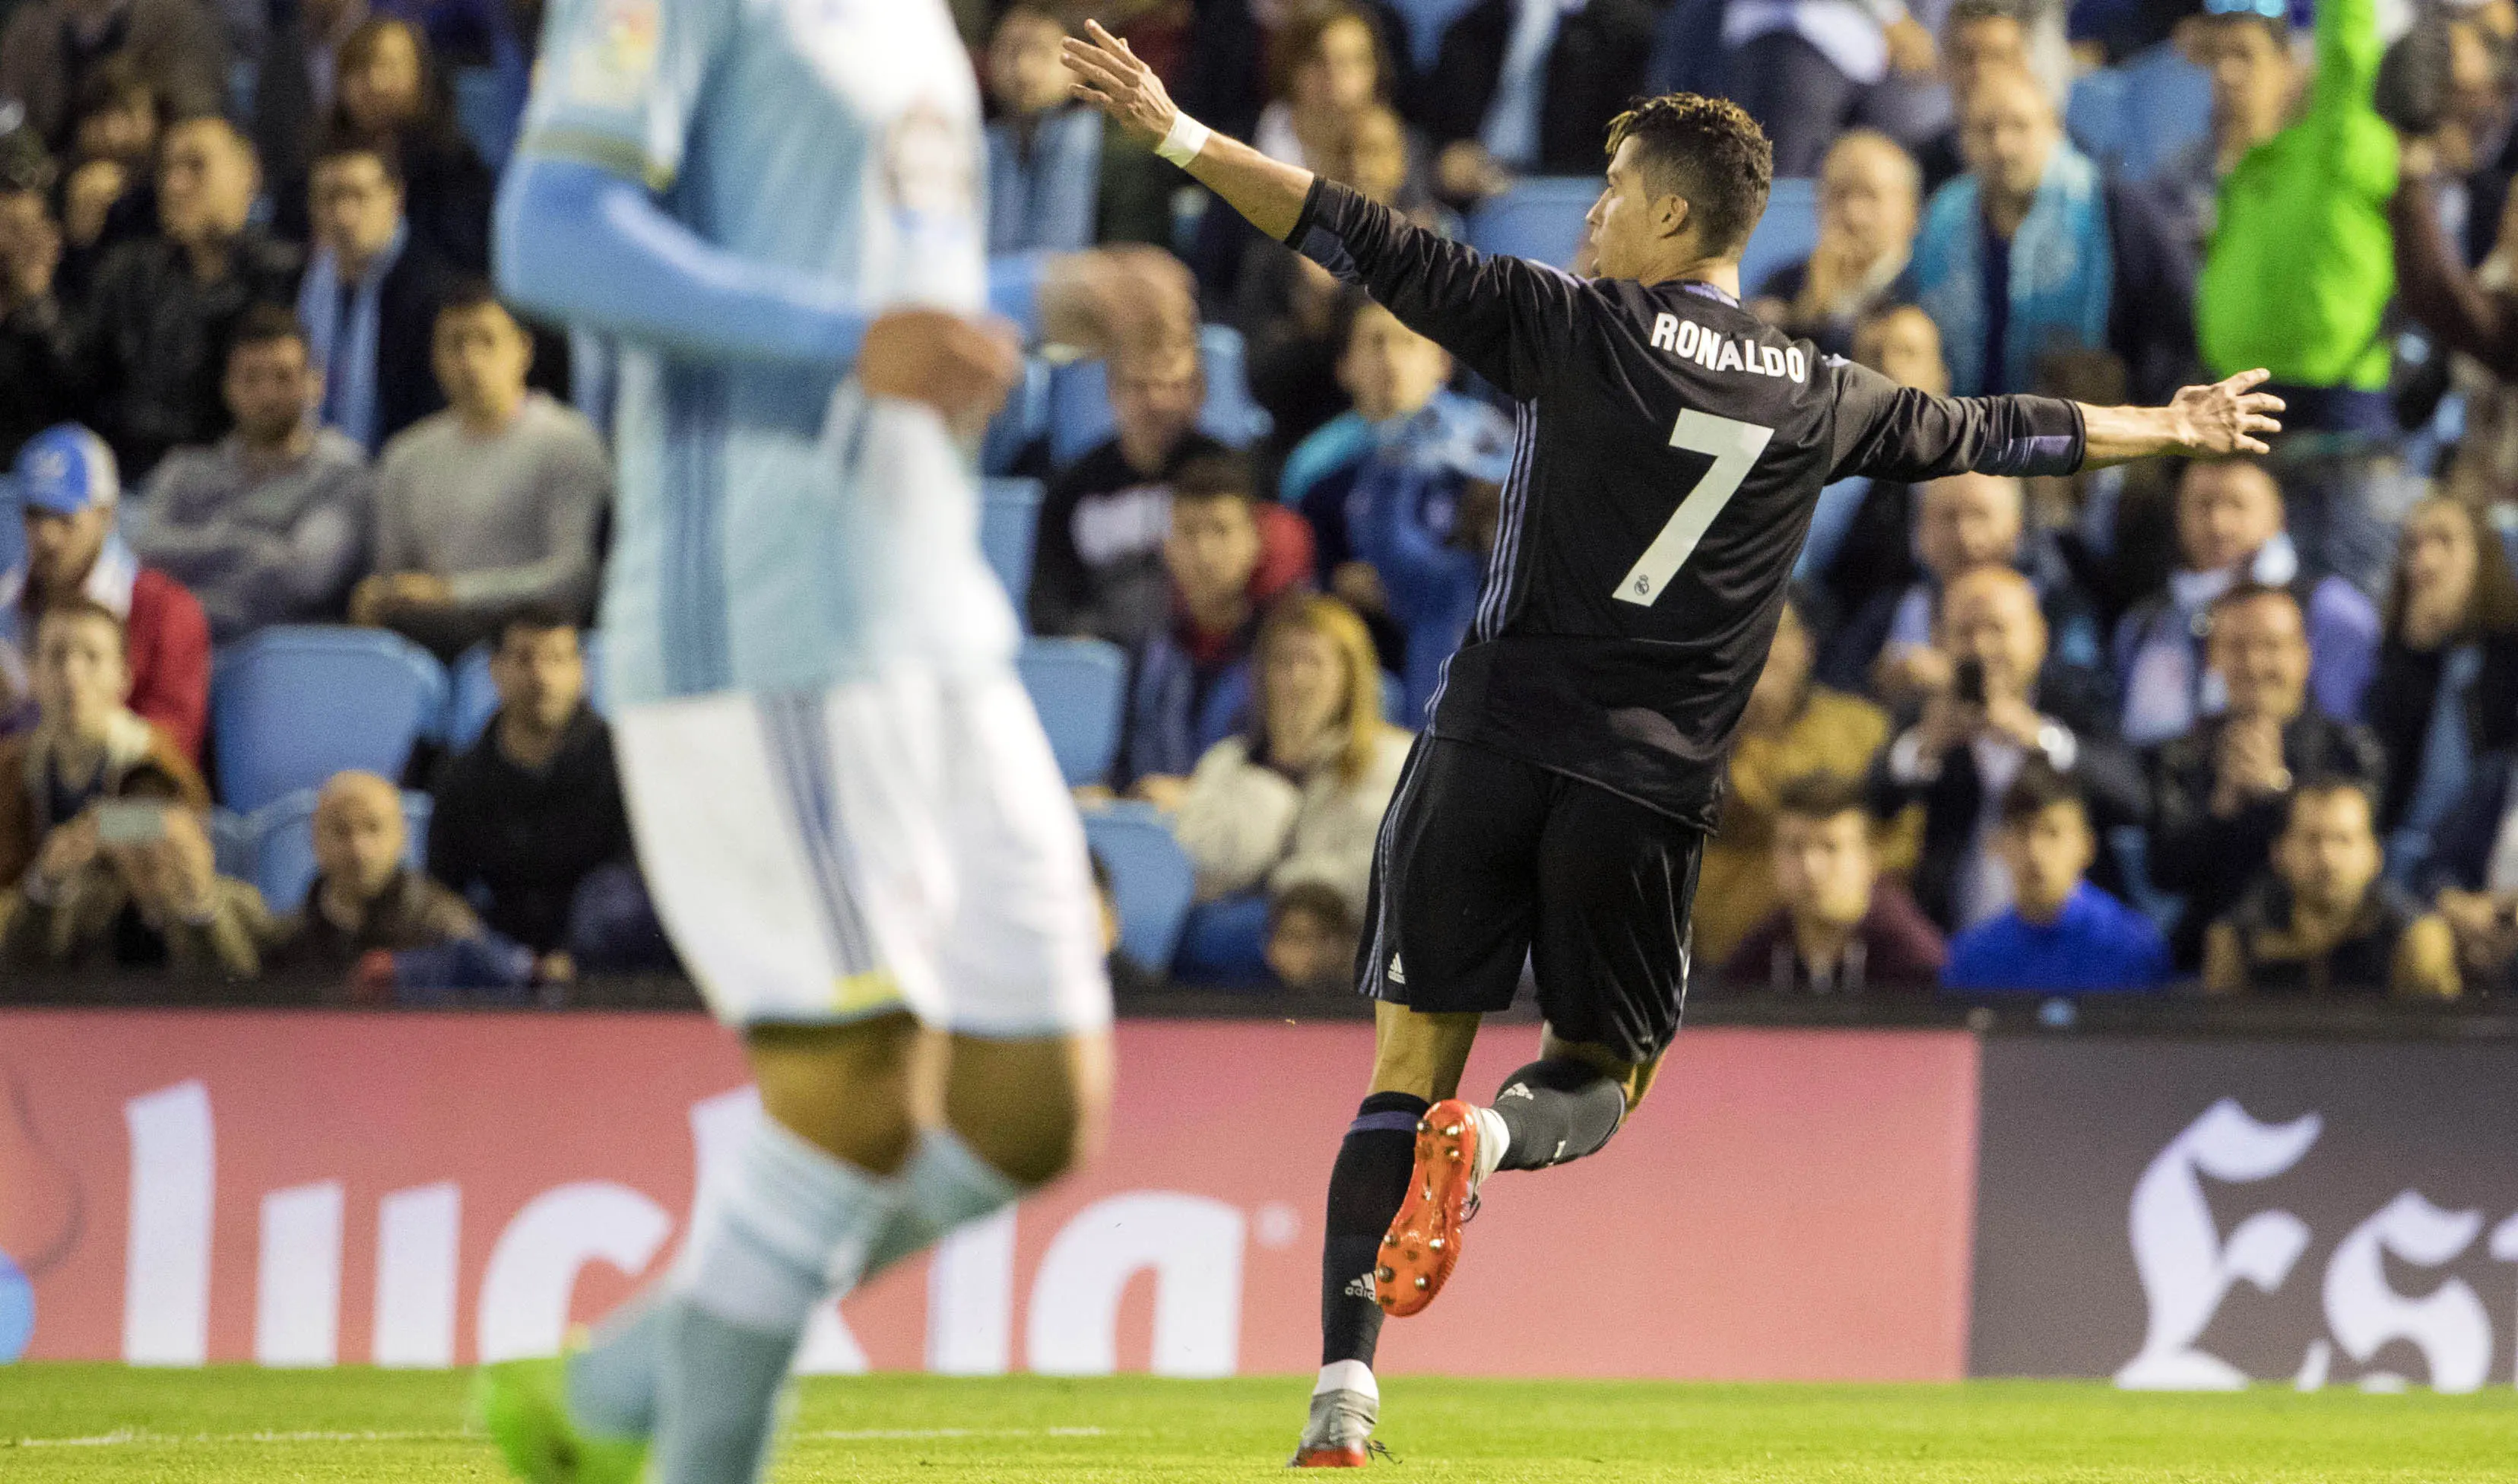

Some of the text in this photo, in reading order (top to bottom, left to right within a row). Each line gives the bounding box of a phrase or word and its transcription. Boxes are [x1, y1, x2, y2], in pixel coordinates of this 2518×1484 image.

[1651, 312, 1806, 383] RONALDO
[1612, 407, 1775, 607] 7
[1345, 1286, 1377, 1302] adid
[2113, 1096, 2518, 1394] Es
